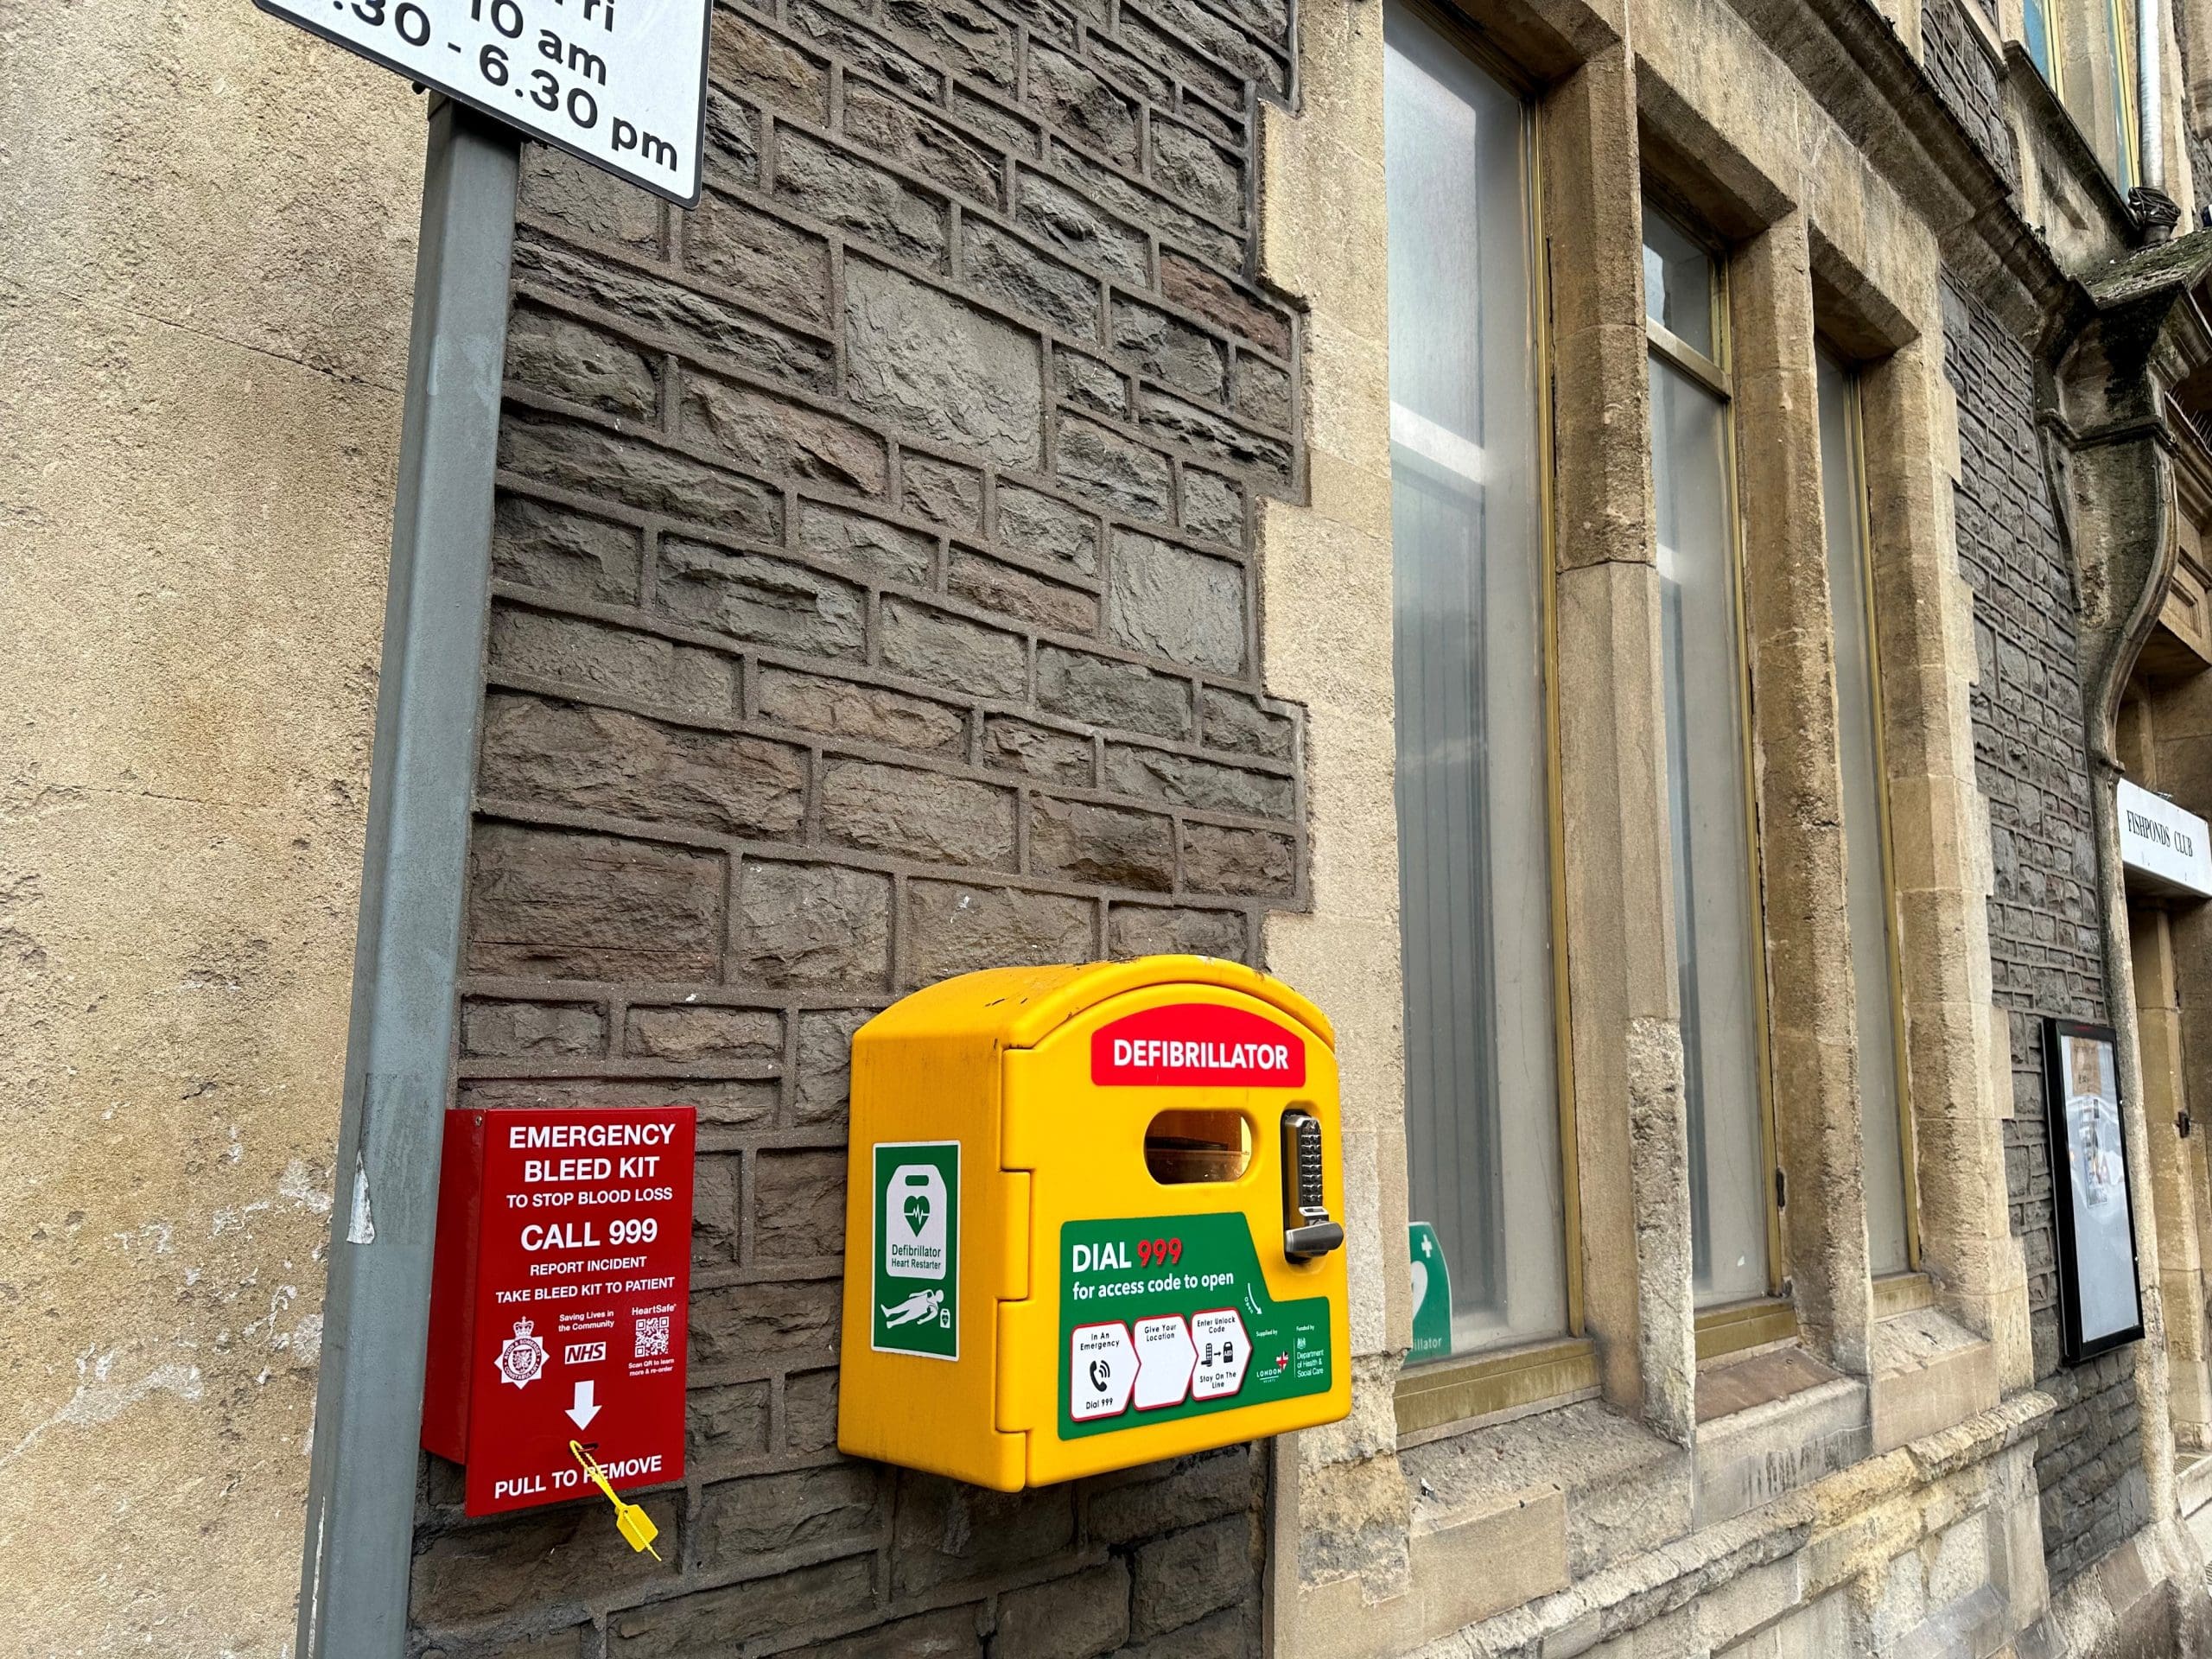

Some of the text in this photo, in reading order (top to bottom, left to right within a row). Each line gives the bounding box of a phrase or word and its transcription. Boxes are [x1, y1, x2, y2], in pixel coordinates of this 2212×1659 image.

[555, 0, 614, 32] ri
[538, 29, 607, 86] am
[333, 0, 430, 47] .30
[480, 44, 599, 129] 6.30
[611, 117, 677, 172] pm
[2126, 810, 2193, 857] FISHPONDS CLUB
[1113, 1039, 1289, 1071] DEFIBRILLATOR
[509, 1123, 677, 1149] EMERGENCY
[524, 1156, 660, 1183] BLEED KIT
[506, 1187, 673, 1208] TO STOP BLOOD LOSS
[520, 1218, 658, 1251] CALL 999
[892, 1244, 941, 1257] Defibrillator
[1071, 1237, 1183, 1273] DIAL 999
[530, 1256, 647, 1276] REPORT INCIDENT
[891, 1258, 941, 1269] Heart Restarter
[495, 1277, 675, 1304] TAKE BLEED KIT TO PATIENT
[1072, 1271, 1235, 1300] for access code to open
[559, 1313, 585, 1323] Saving
[572, 1320, 615, 1331] Community
[1197, 1316, 1236, 1328] Enter Unlock
[1144, 1324, 1177, 1334] Give Your
[1146, 1332, 1175, 1342] Location
[1208, 1325, 1225, 1334] Code
[1080, 1339, 1121, 1351] Emergency
[567, 1344, 605, 1363] NHS
[1297, 1350, 1324, 1360] Department
[1303, 1359, 1318, 1368] Health
[1199, 1376, 1214, 1384] Stay
[1256, 1368, 1282, 1377] LONDON
[1297, 1367, 1324, 1378] Social Care
[1085, 1397, 1114, 1409] Dial 999
[494, 1455, 663, 1499] PULL TO REMOVE
